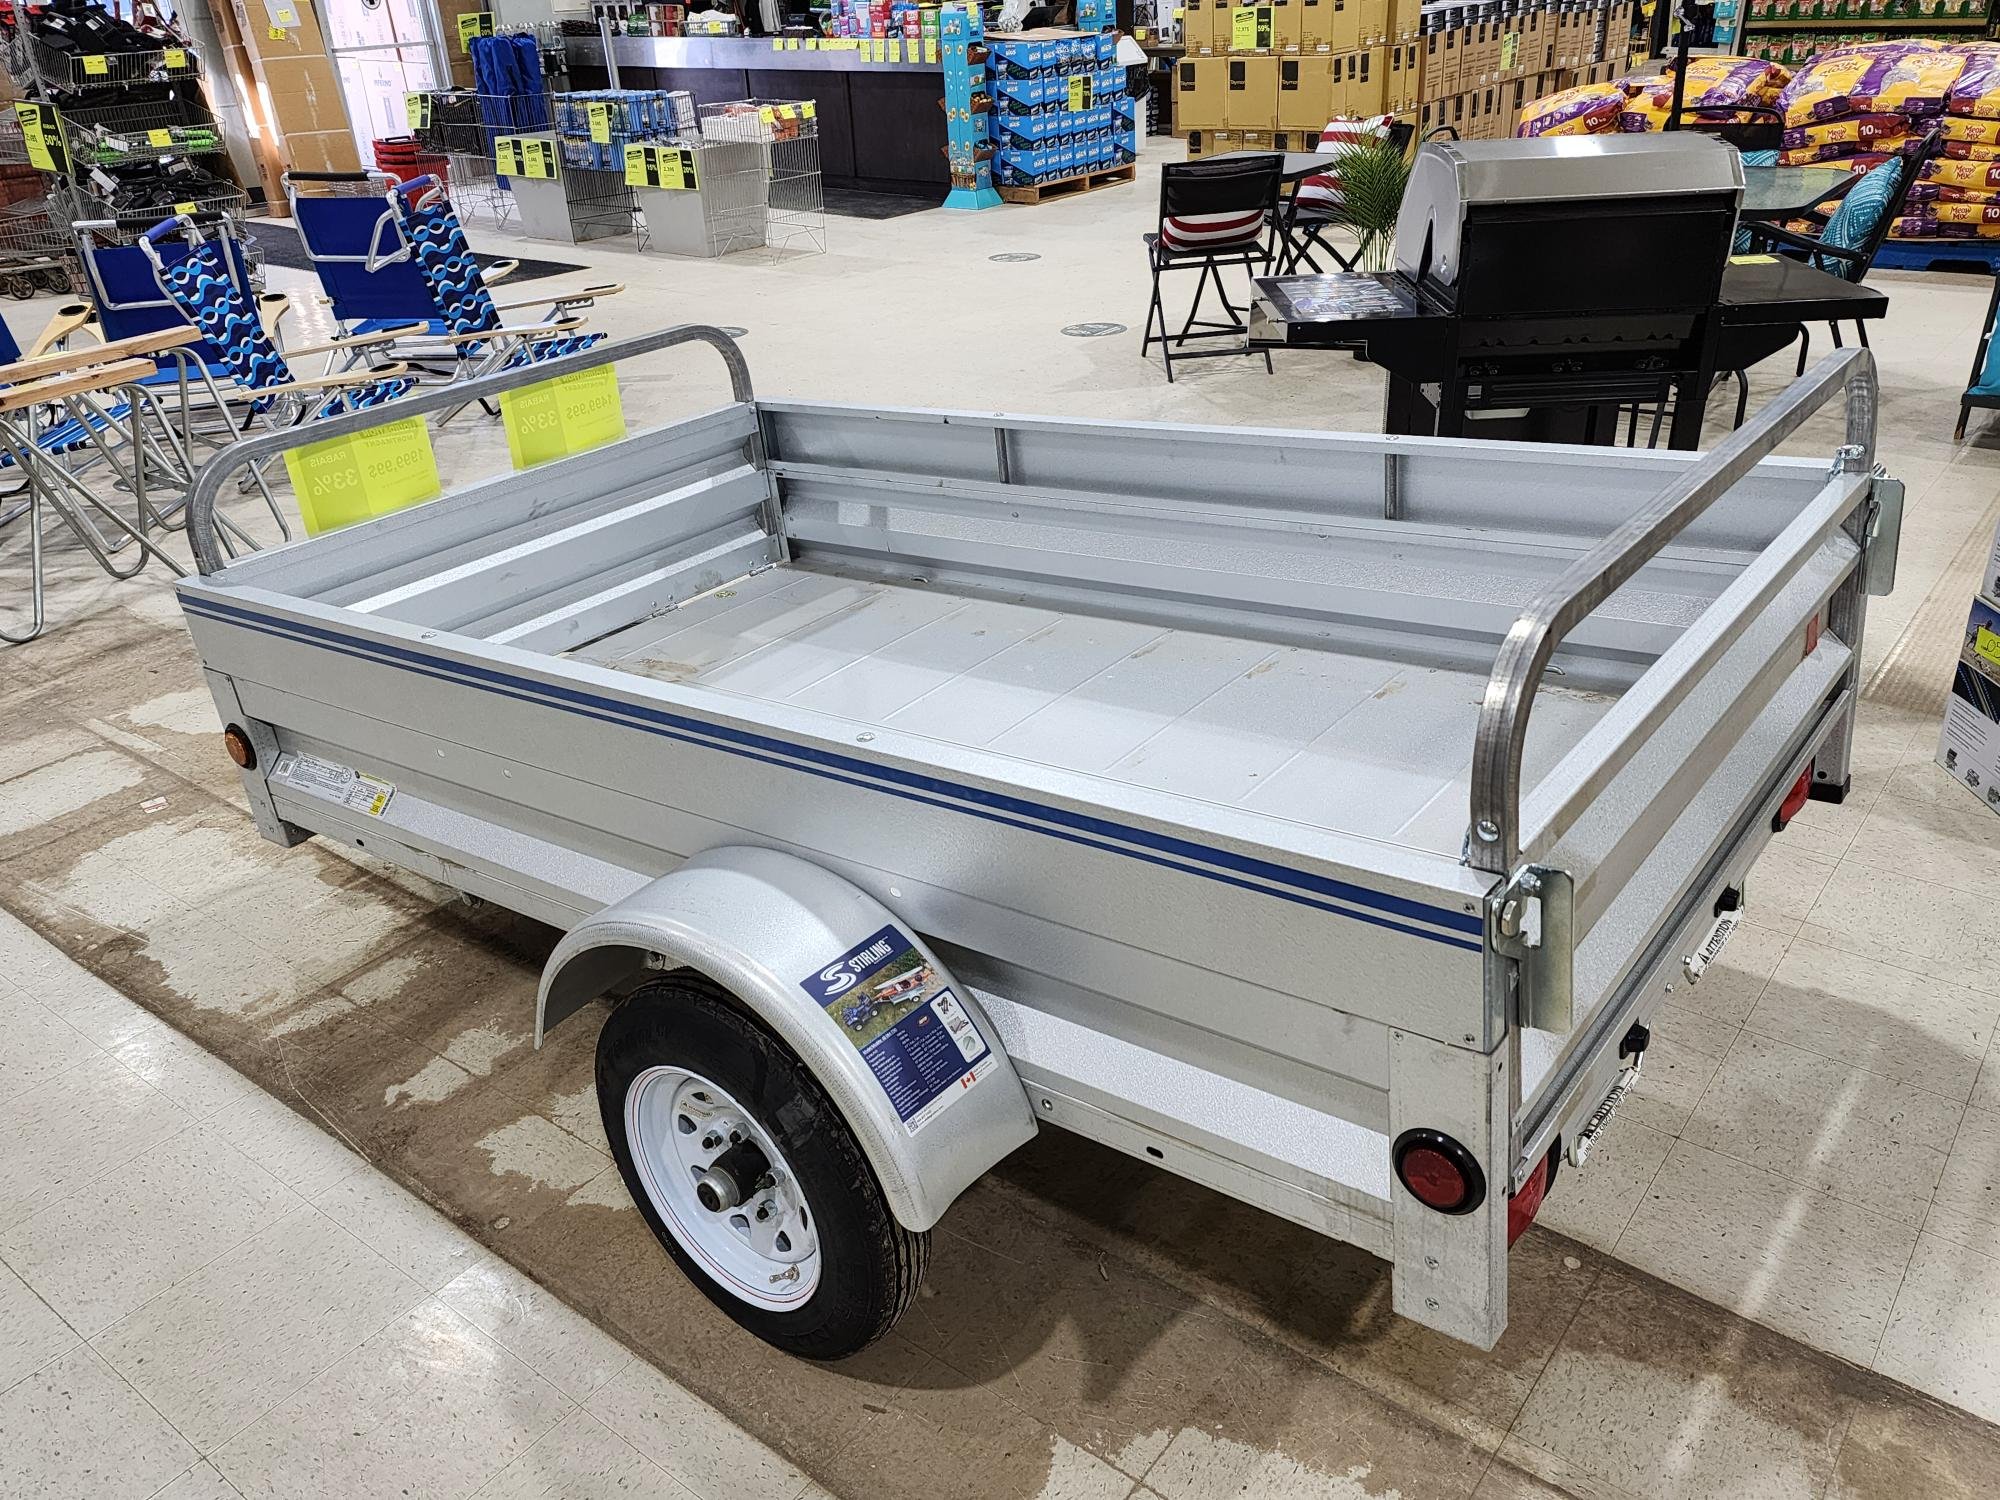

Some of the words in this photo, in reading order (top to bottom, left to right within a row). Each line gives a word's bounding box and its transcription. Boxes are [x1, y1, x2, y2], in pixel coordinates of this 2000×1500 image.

[1586, 117, 1598, 127] 10
[1827, 125, 1847, 137] Meow
[1860, 125, 1874, 135] 10
[1965, 124, 1986, 134] Meow
[44, 134, 62, 147] 50%
[1966, 132, 1981, 140] Mix
[1852, 165, 1867, 175] 10
[1955, 163, 1976, 174] Meow
[1957, 172, 1970, 180] Mix
[1951, 206, 1971, 214] Meow
[1986, 208, 2000, 218] 10
[1705, 918, 1733, 956] ATTENTION
[848, 939, 892, 973] STIRLING
[1586, 1085, 1624, 1131] CAUTION
